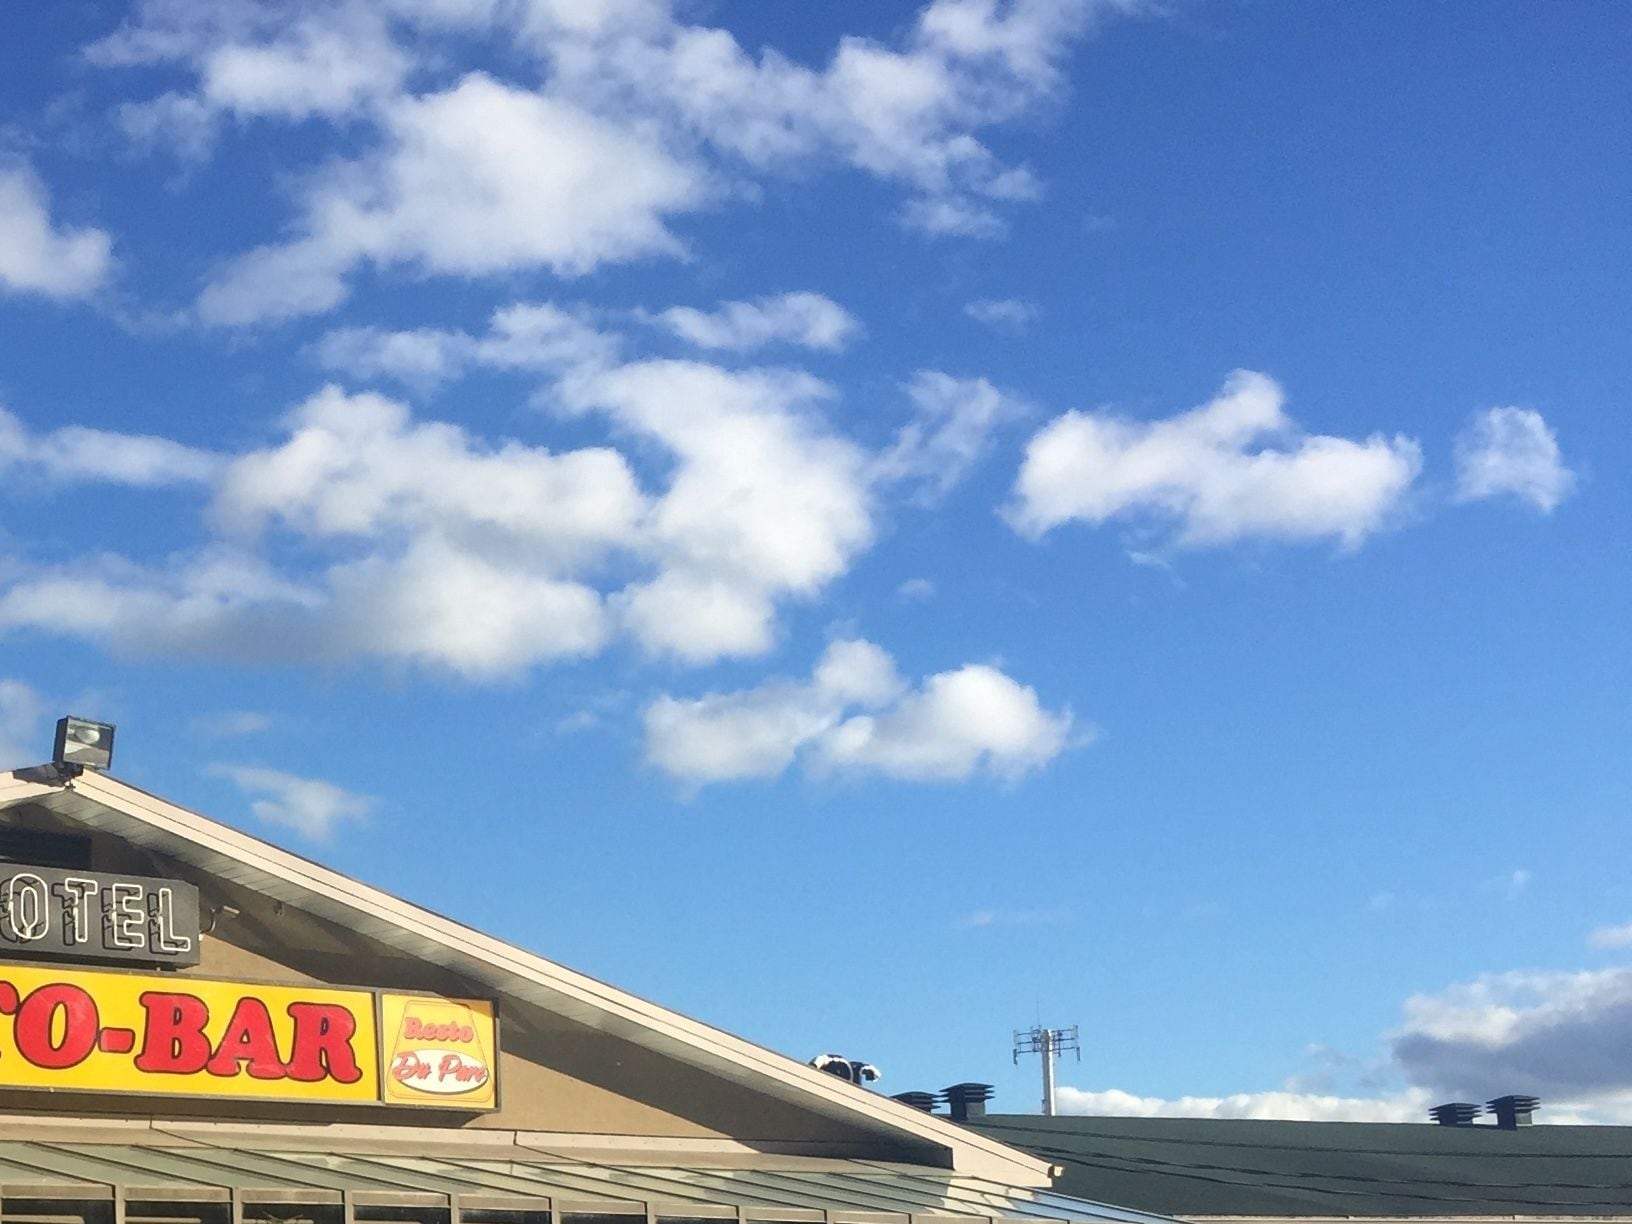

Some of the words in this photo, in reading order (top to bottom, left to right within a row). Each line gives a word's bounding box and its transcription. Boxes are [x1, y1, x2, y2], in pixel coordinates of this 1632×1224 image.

[403, 1016, 474, 1043] Resto
[392, 1050, 432, 1081] Du
[438, 1054, 487, 1083] Parc
